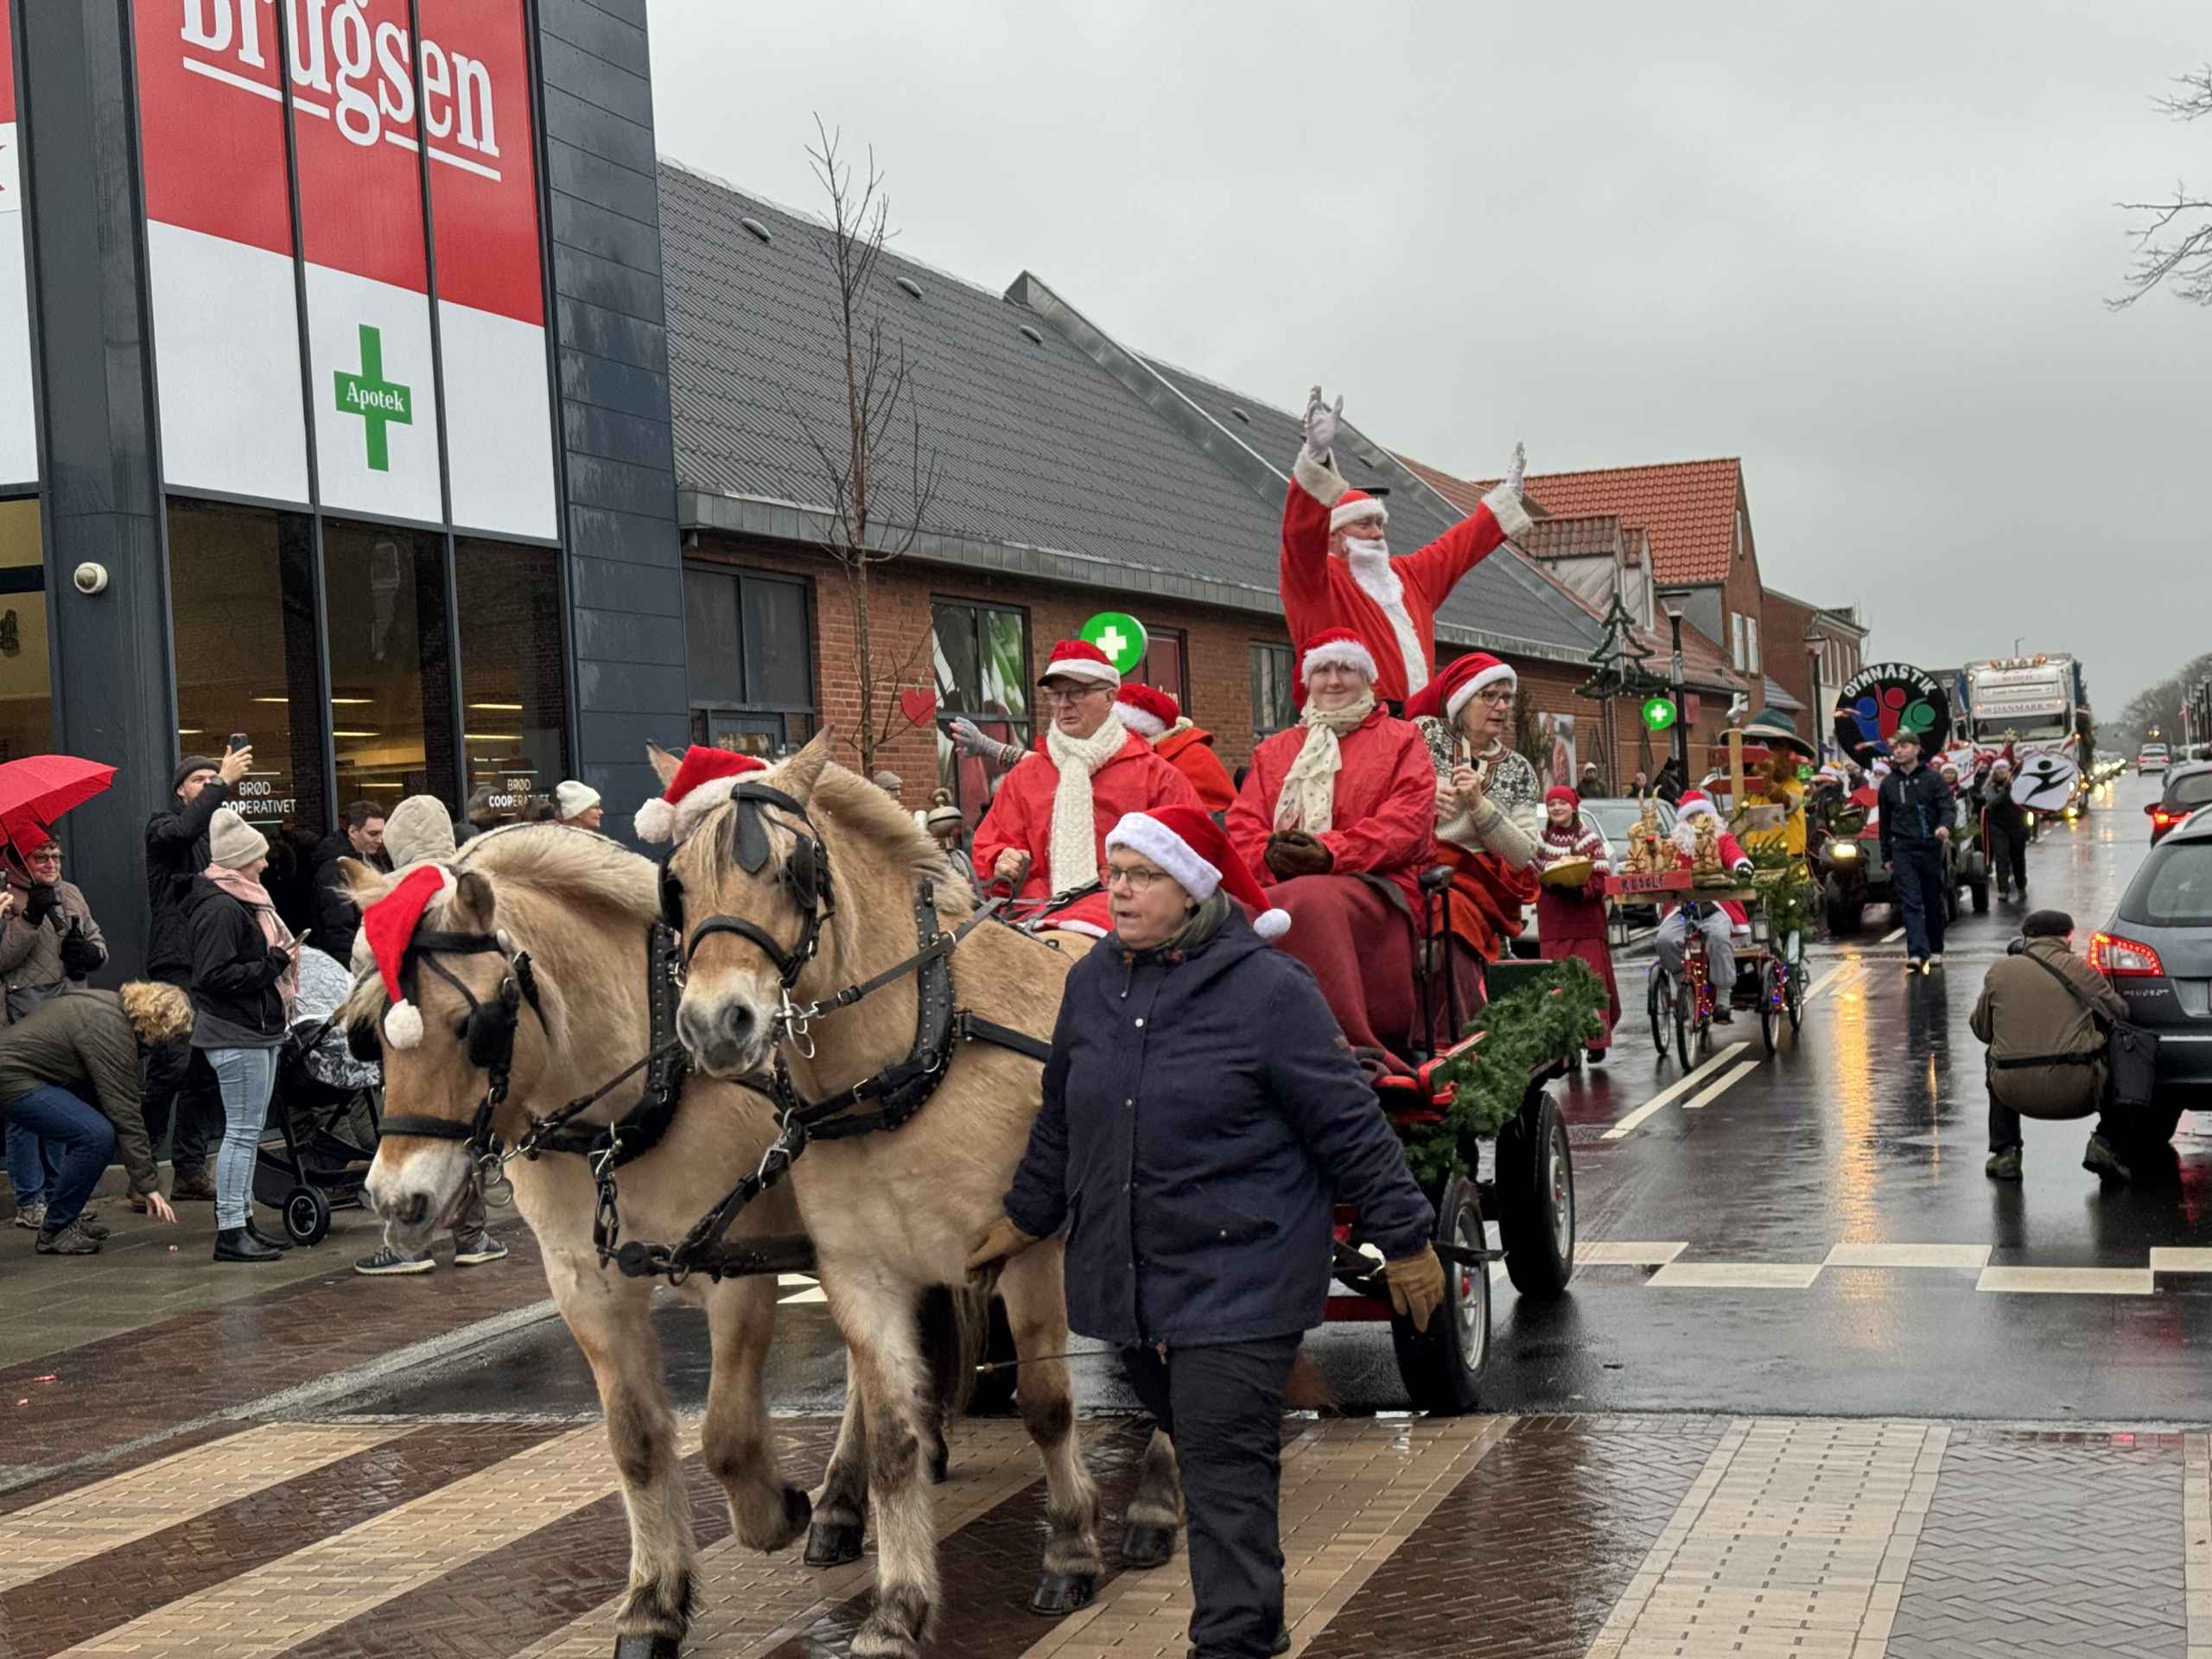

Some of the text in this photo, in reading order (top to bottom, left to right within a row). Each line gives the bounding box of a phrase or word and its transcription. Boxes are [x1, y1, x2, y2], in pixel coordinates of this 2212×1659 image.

[346, 381, 405, 412] Apotek
[1844, 664, 1937, 697] GYMNASTIK
[1993, 702, 2045, 714] DANMARK
[238, 781, 270, 796] BRØD
[507, 779, 531, 791] BRØD
[221, 799, 296, 814] OPERATIVET
[1621, 874, 1664, 892] RUDOLF
